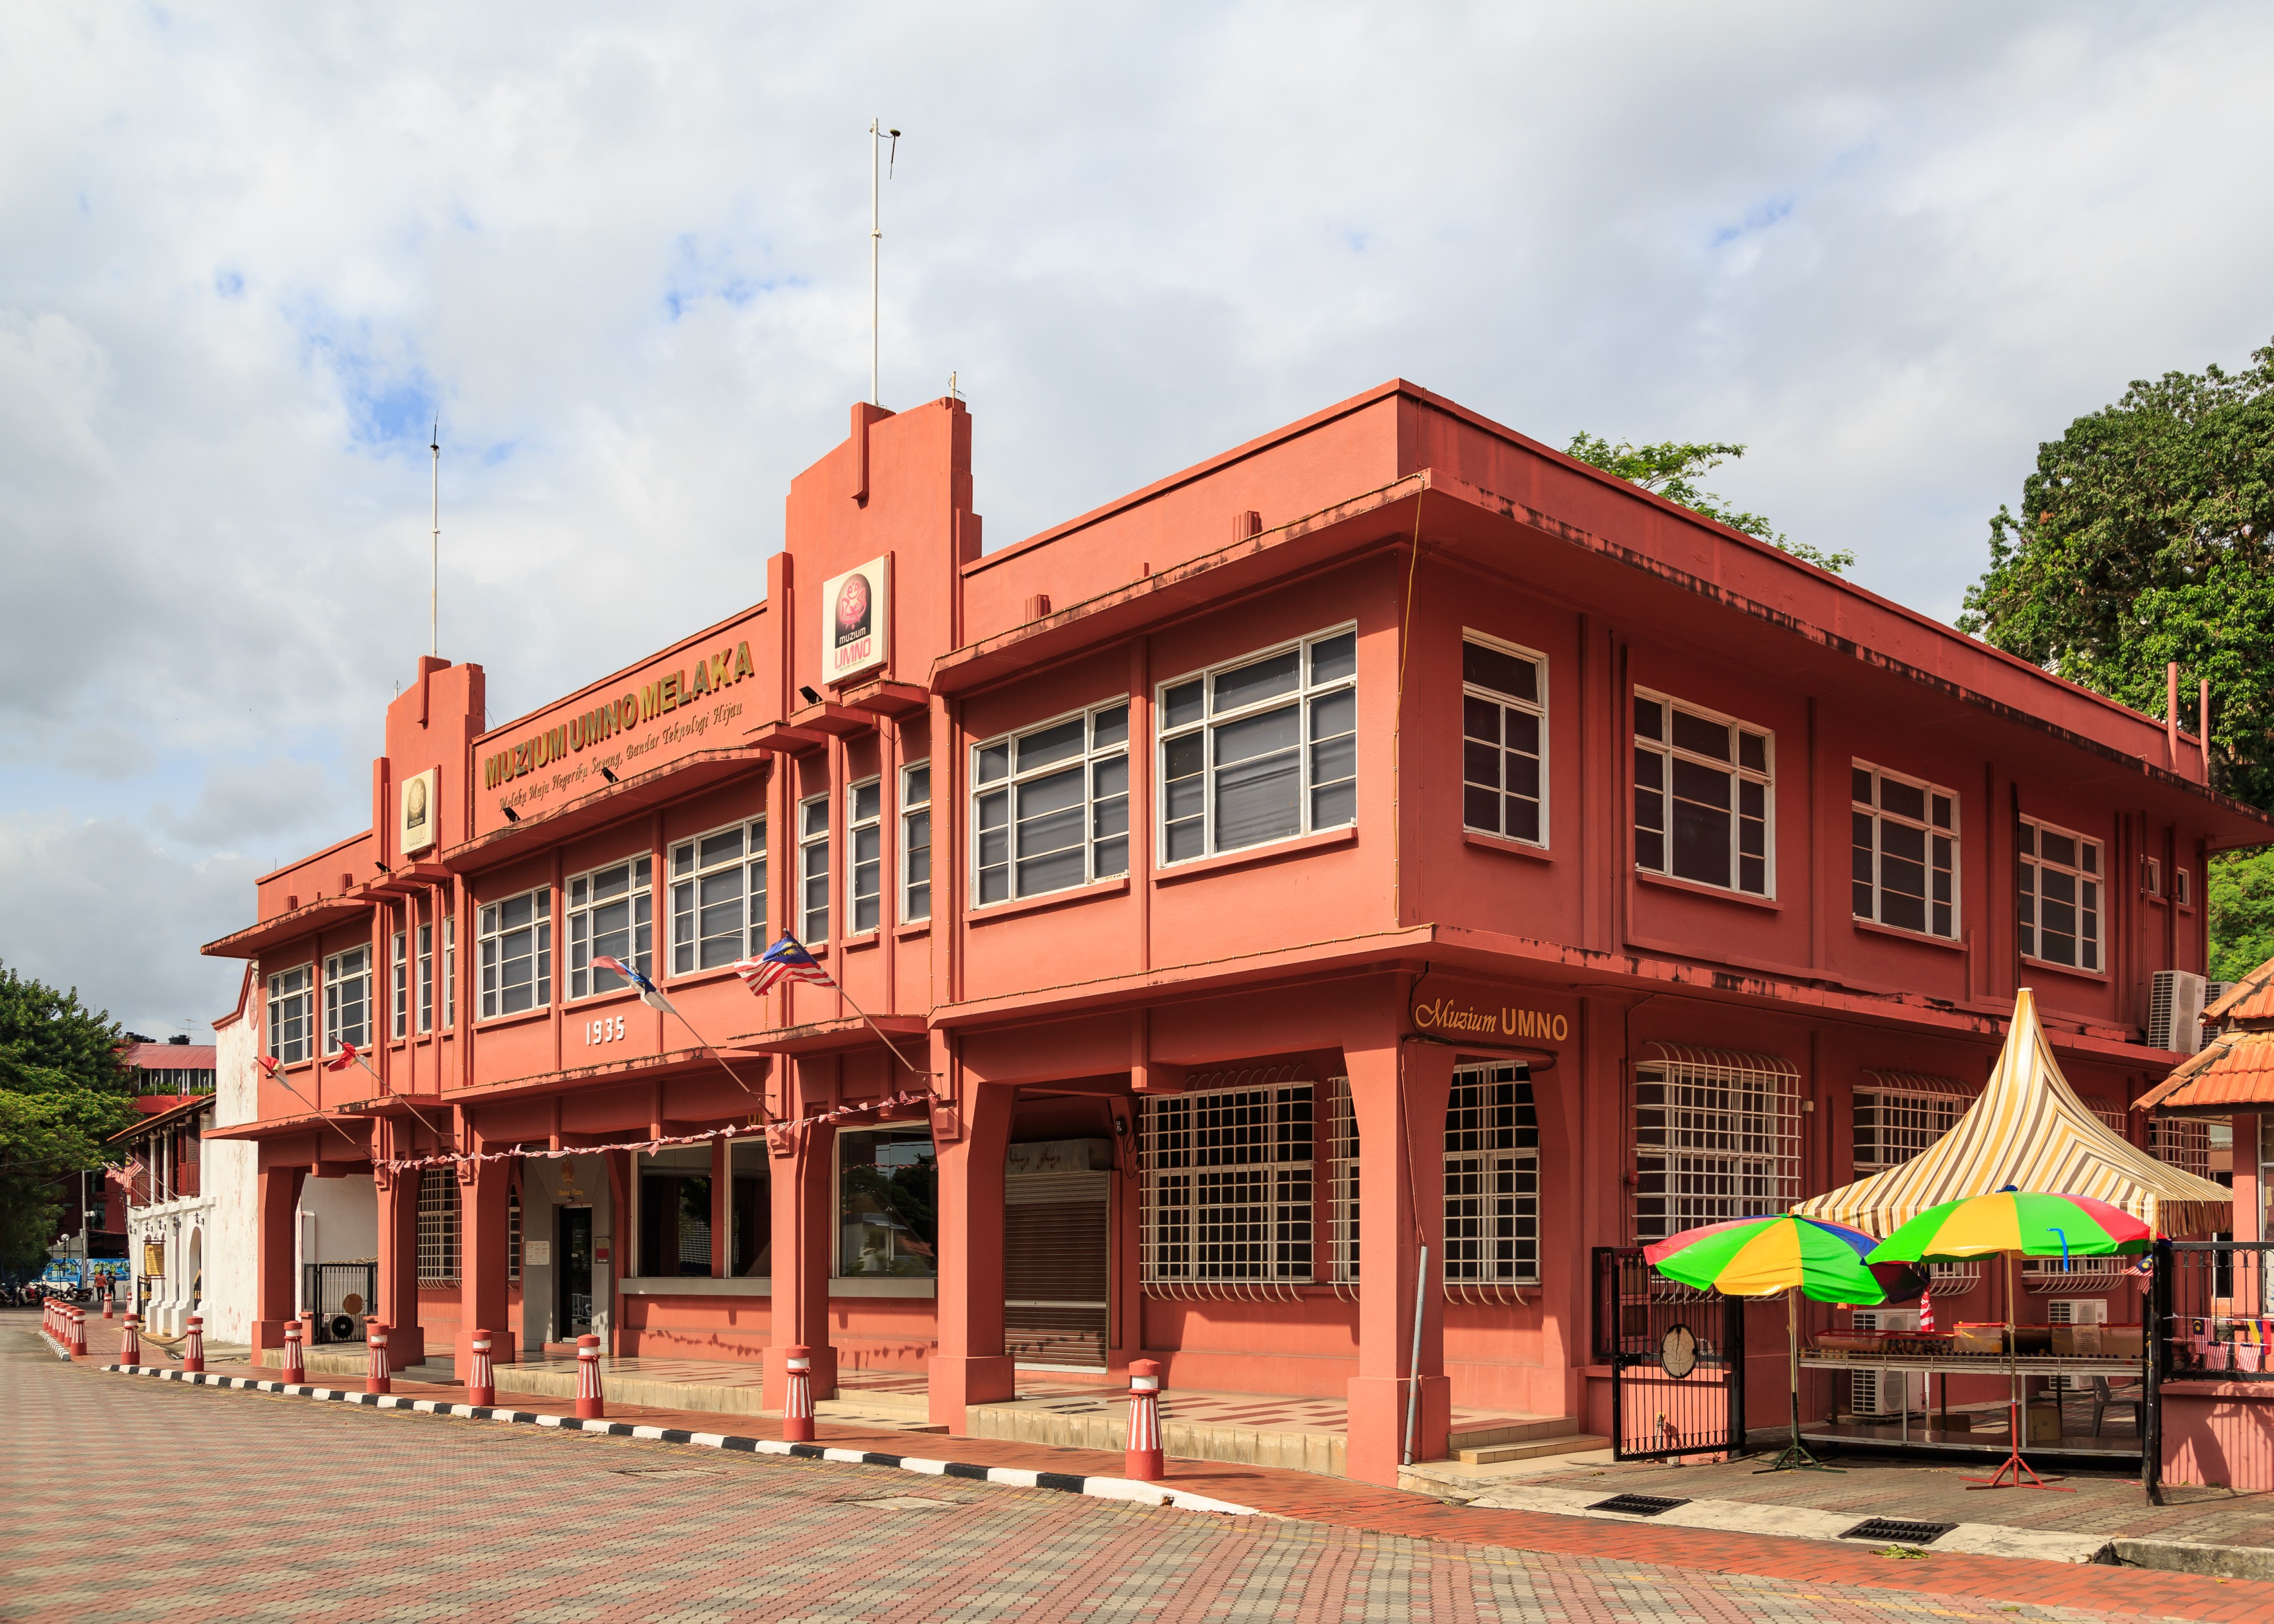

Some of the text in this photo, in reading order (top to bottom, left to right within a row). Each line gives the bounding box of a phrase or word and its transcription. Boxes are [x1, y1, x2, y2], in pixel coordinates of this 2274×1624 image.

[835, 637, 871, 669] UMNO
[839, 627, 866, 645] MUZIUM
[484, 641, 755, 789] MUZIUM UMNO MELAKA
[499, 702, 742, 812] Melaka Maju Negeriku Sayang, Bandar Teknologi Hijau
[587, 1015, 626, 1046] 1935
[1415, 998, 1568, 1041] Muzium UMNO
